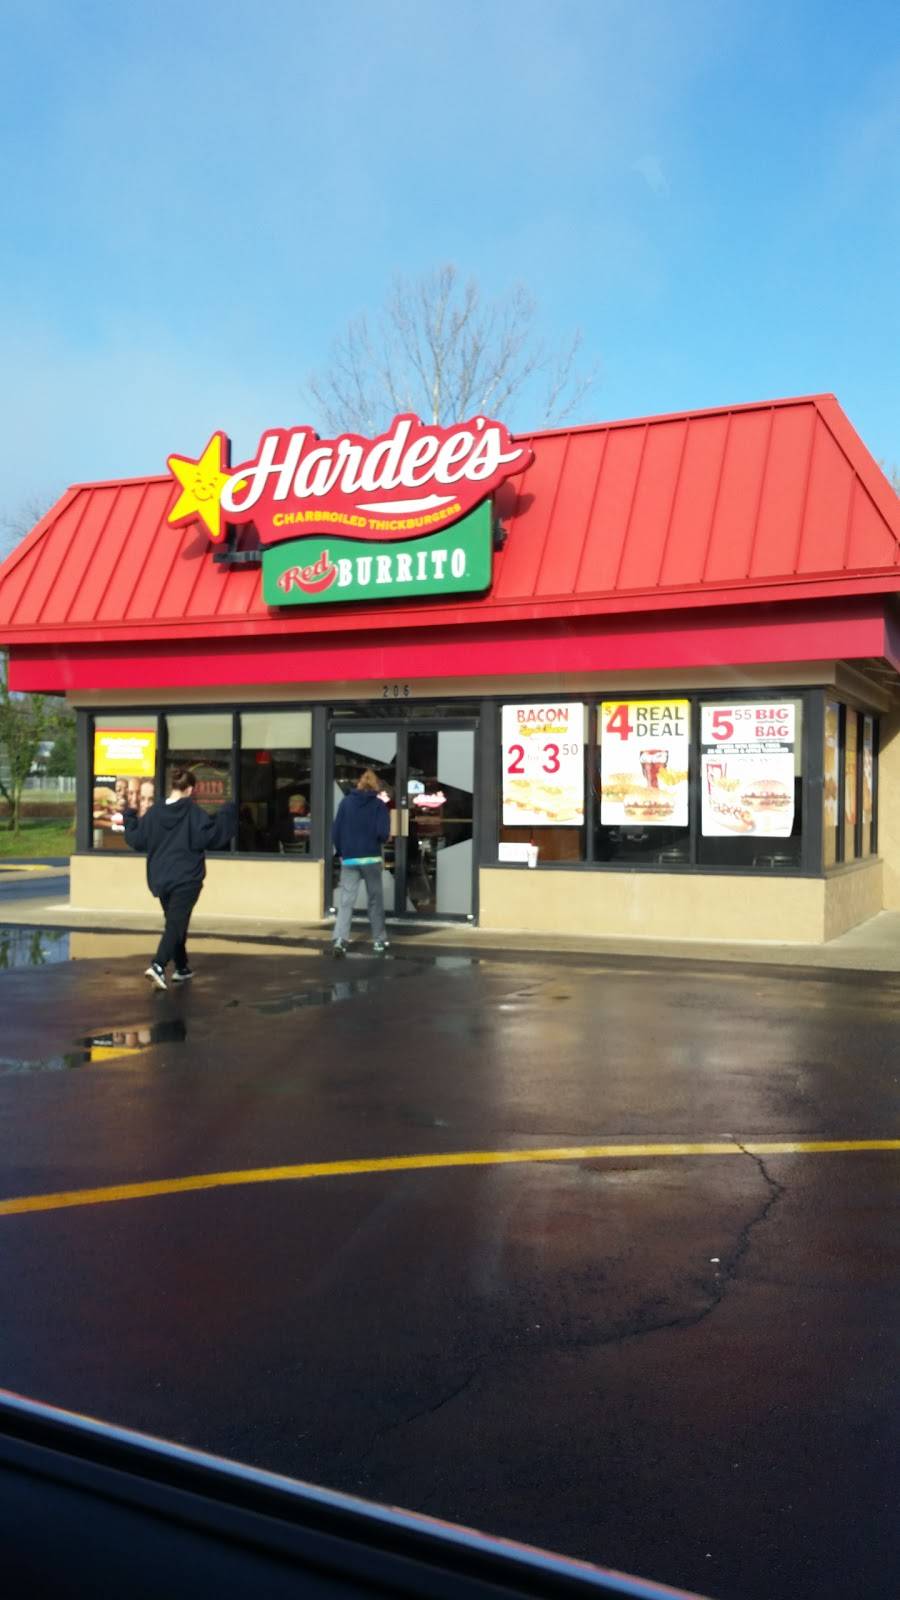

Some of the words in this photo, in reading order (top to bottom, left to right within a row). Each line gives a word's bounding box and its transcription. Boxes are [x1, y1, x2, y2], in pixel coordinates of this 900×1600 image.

[220, 417, 522, 512] Hardee's
[273, 510, 367, 527] CHARBROILED
[369, 503, 462, 531] THICKBURGERS
[277, 550, 338, 594] Red
[337, 548, 466, 587] BURRITO
[383, 685, 409, 697] 206
[517, 708, 569, 722] BACON
[637, 706, 685, 721] REAL
[755, 708, 789, 720] BIG
[637, 723, 685, 737] DEAL
[755, 725, 789, 737] BAG
[507, 744, 525, 774] 2
